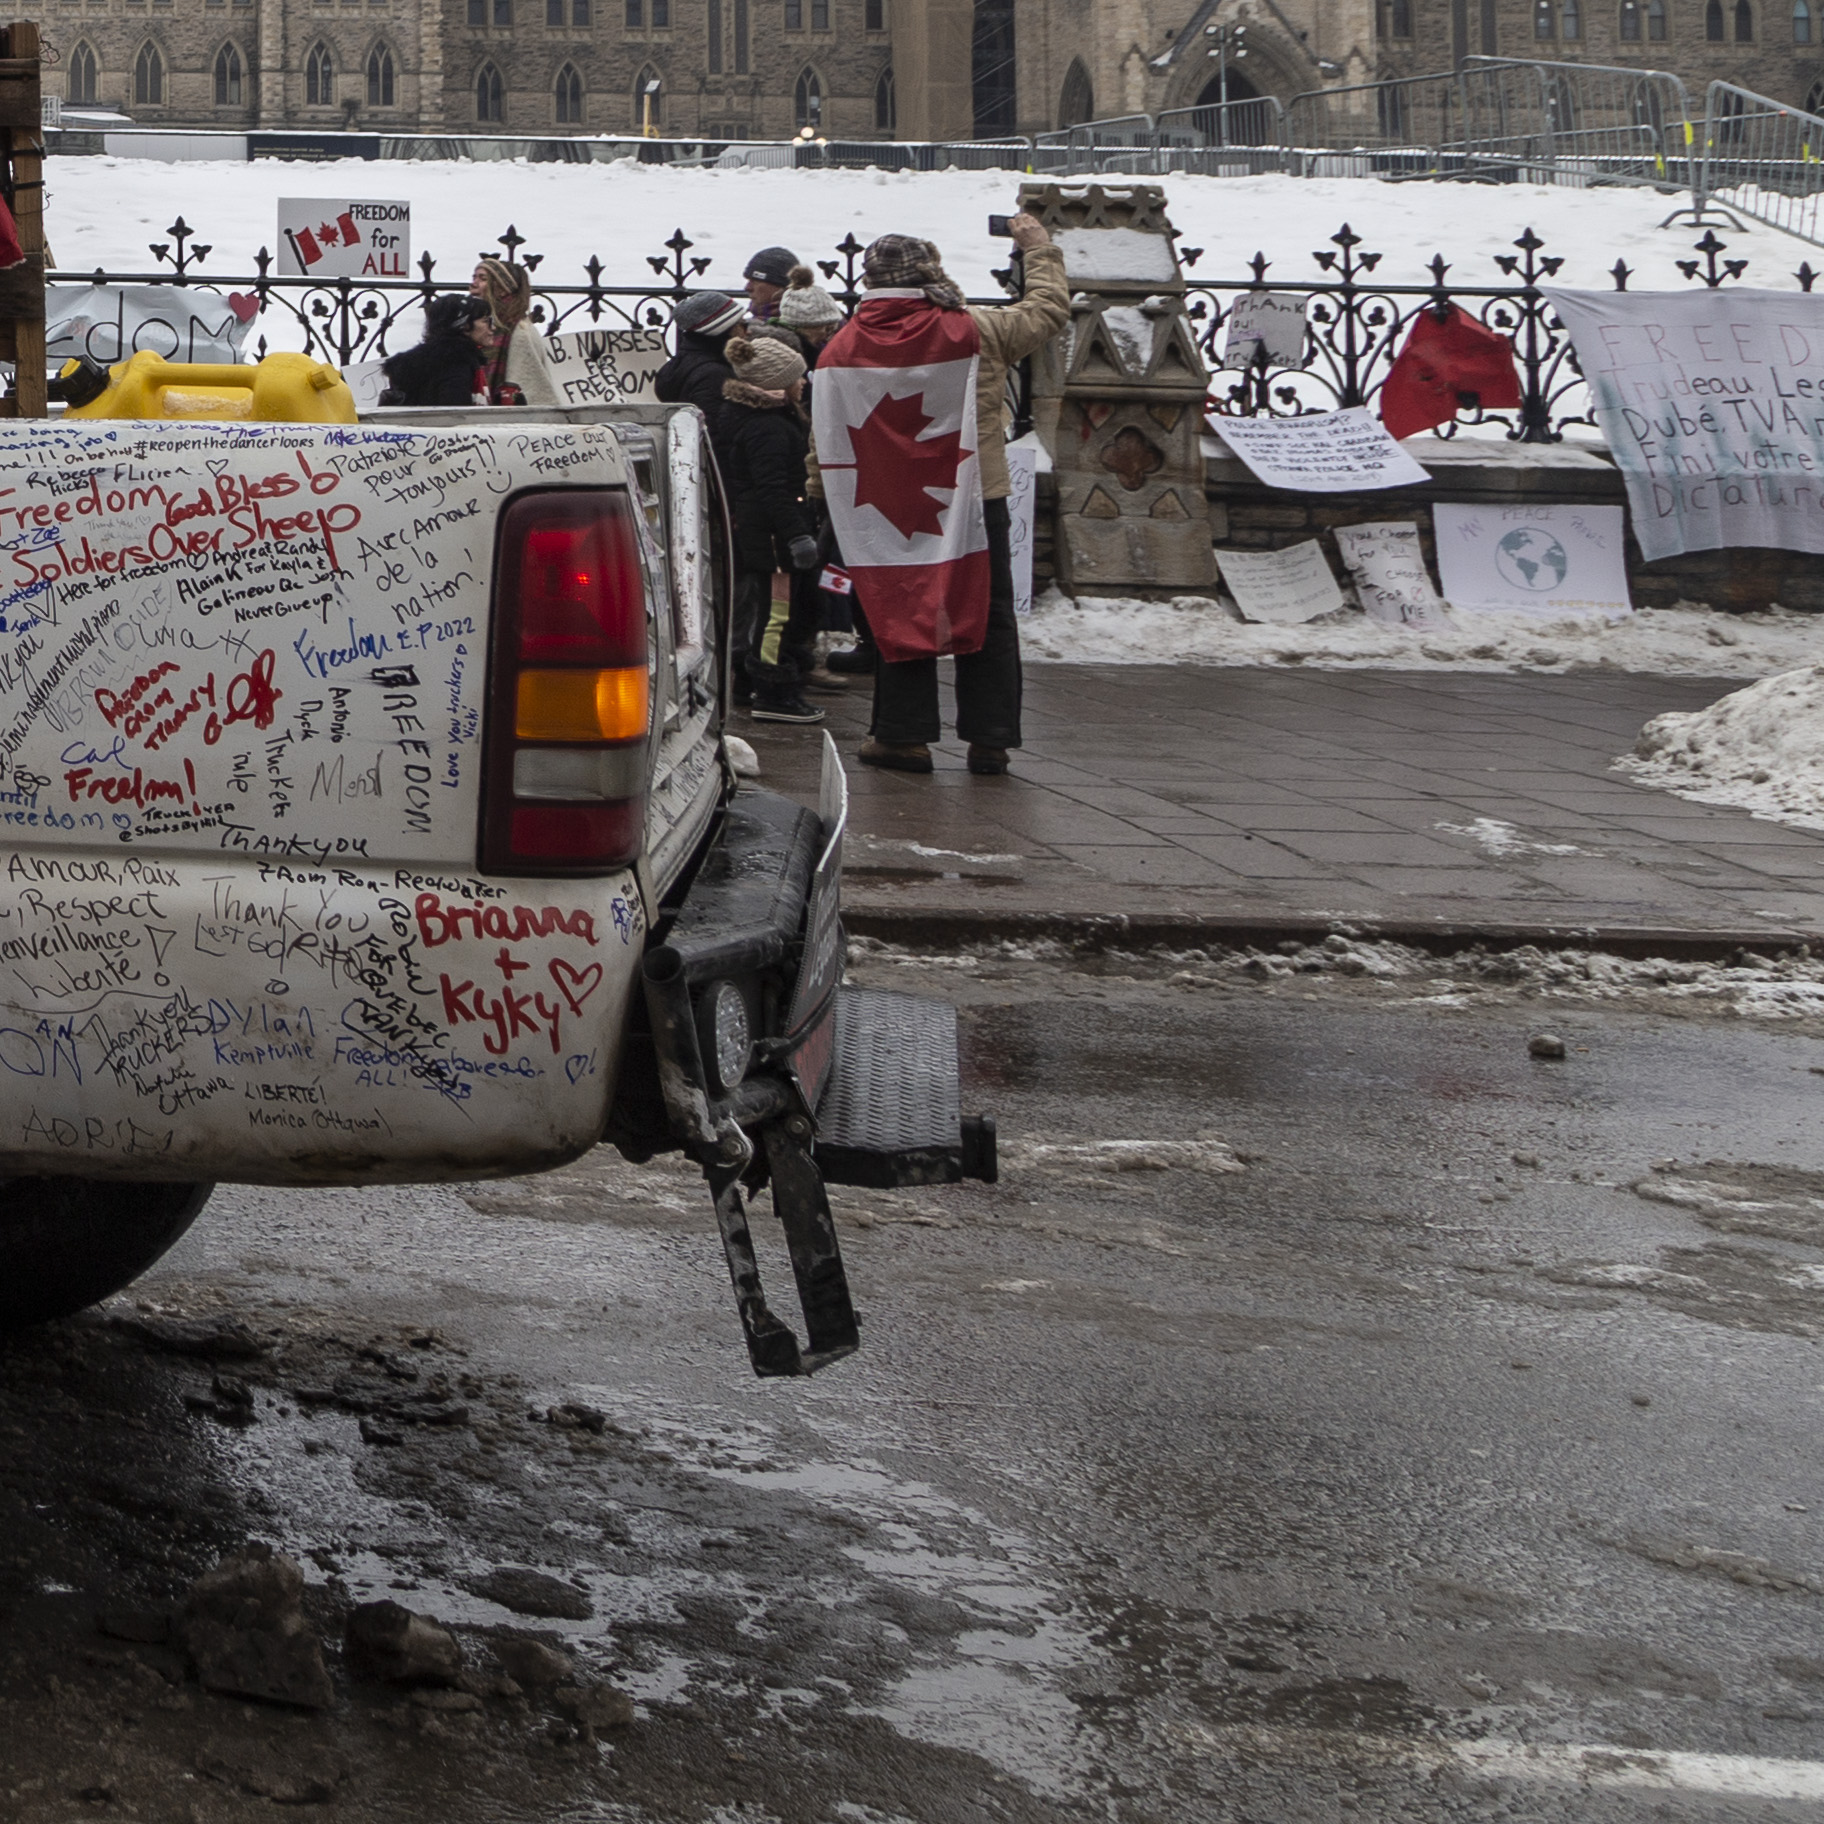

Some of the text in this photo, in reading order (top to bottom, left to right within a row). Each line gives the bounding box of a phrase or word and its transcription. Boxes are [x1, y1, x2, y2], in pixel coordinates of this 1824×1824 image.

[349, 204, 410, 222] FREEDOM
[371, 228, 399, 249] for
[362, 252, 406, 275] ALL
[576, 330, 661, 357] NURSES
[1722, 399, 1808, 435] TVA
[377, 546, 439, 592] de la
[328, 686, 352, 745] Antonio
[20, 887, 168, 925] Respect
[415, 893, 600, 947] Brianna
[494, 947, 530, 980] +
[440, 973, 562, 1055] Kyky
[245, 1076, 328, 1105] LIBERTÉ!
